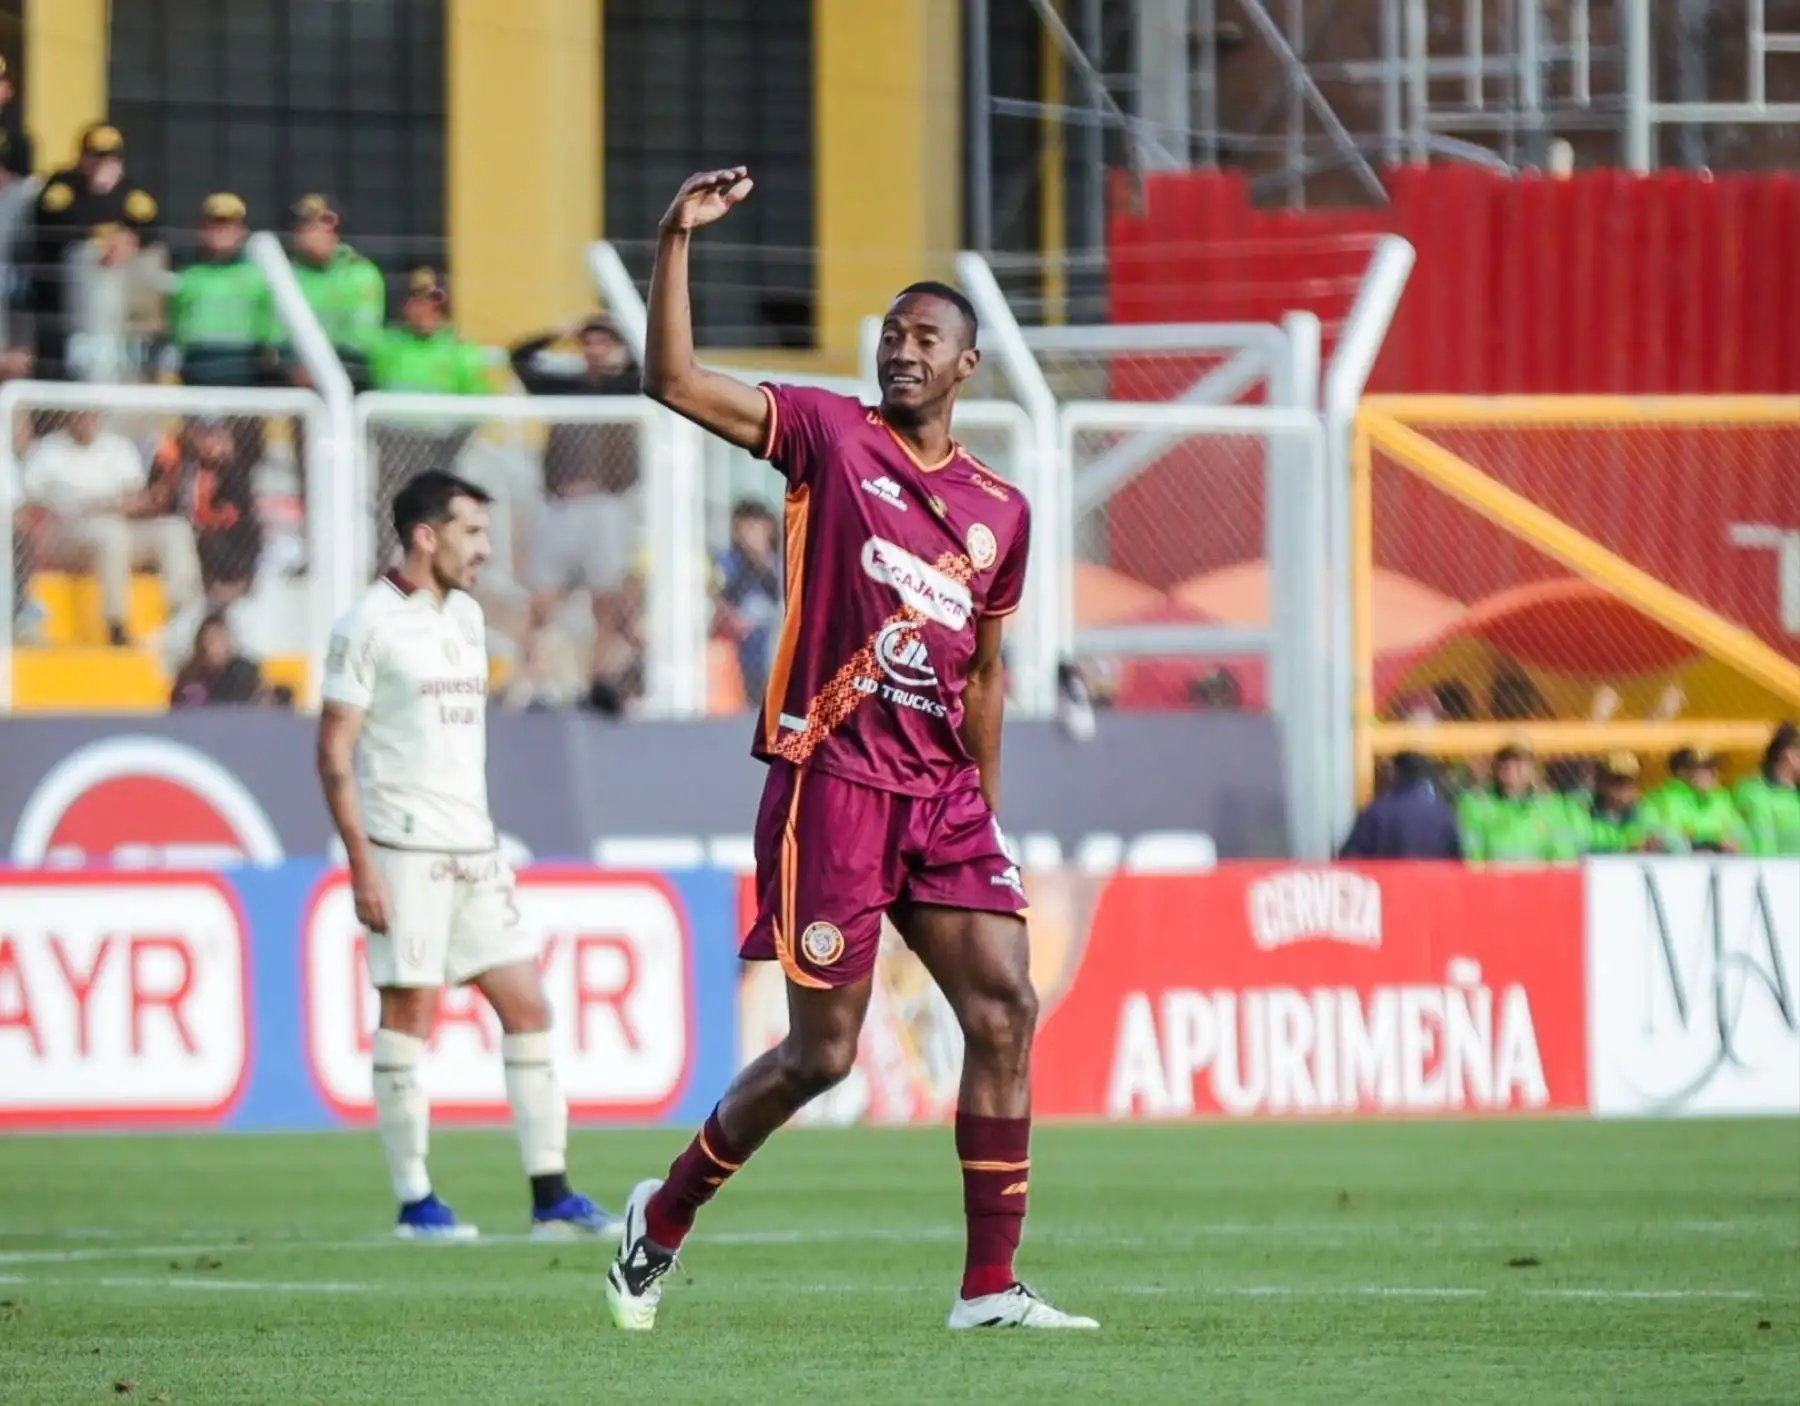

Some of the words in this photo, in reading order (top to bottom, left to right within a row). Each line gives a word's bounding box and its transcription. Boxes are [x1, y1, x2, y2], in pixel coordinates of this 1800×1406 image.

[852, 675, 880, 694] UD
[881, 683, 948, 718] TRUCKS
[1247, 871, 1382, 951] CERVEZA
[1108, 955, 1551, 1118] APURIMEÑA
